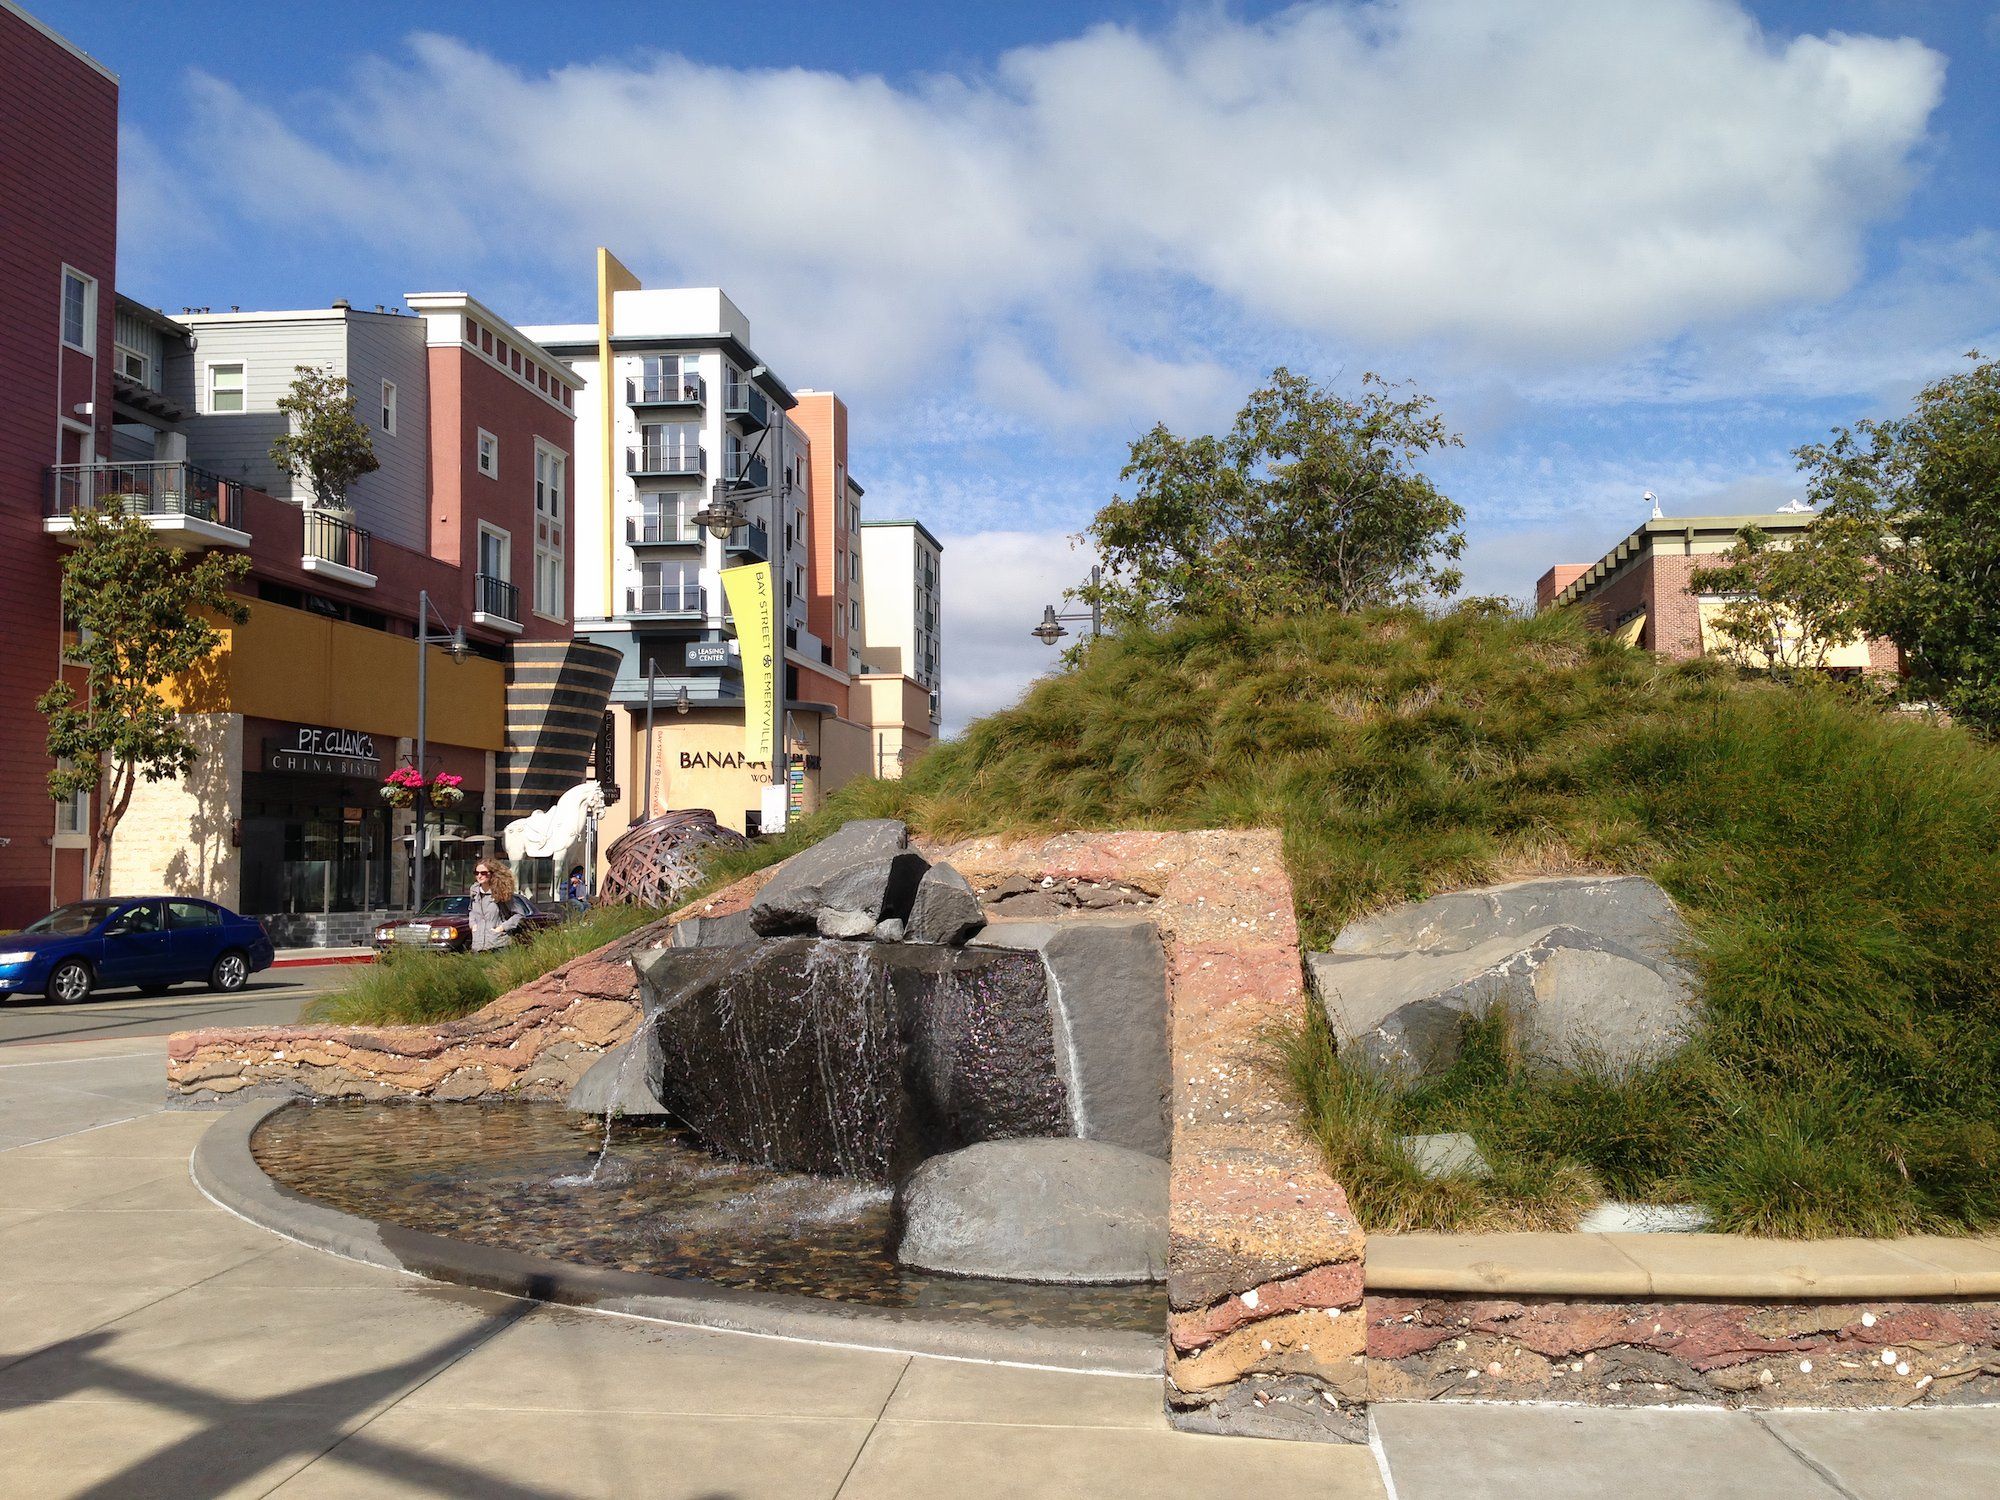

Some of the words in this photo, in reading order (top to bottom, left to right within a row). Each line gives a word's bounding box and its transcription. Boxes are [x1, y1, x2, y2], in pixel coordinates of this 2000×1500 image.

[755, 571, 766, 596] BAY
[759, 600, 771, 650] STREET
[699, 654, 724, 662] CENTER
[760, 671, 772, 754] EMERYVILLE
[325, 728, 374, 760] CHANG'S
[272, 755, 332, 773] CHINA
